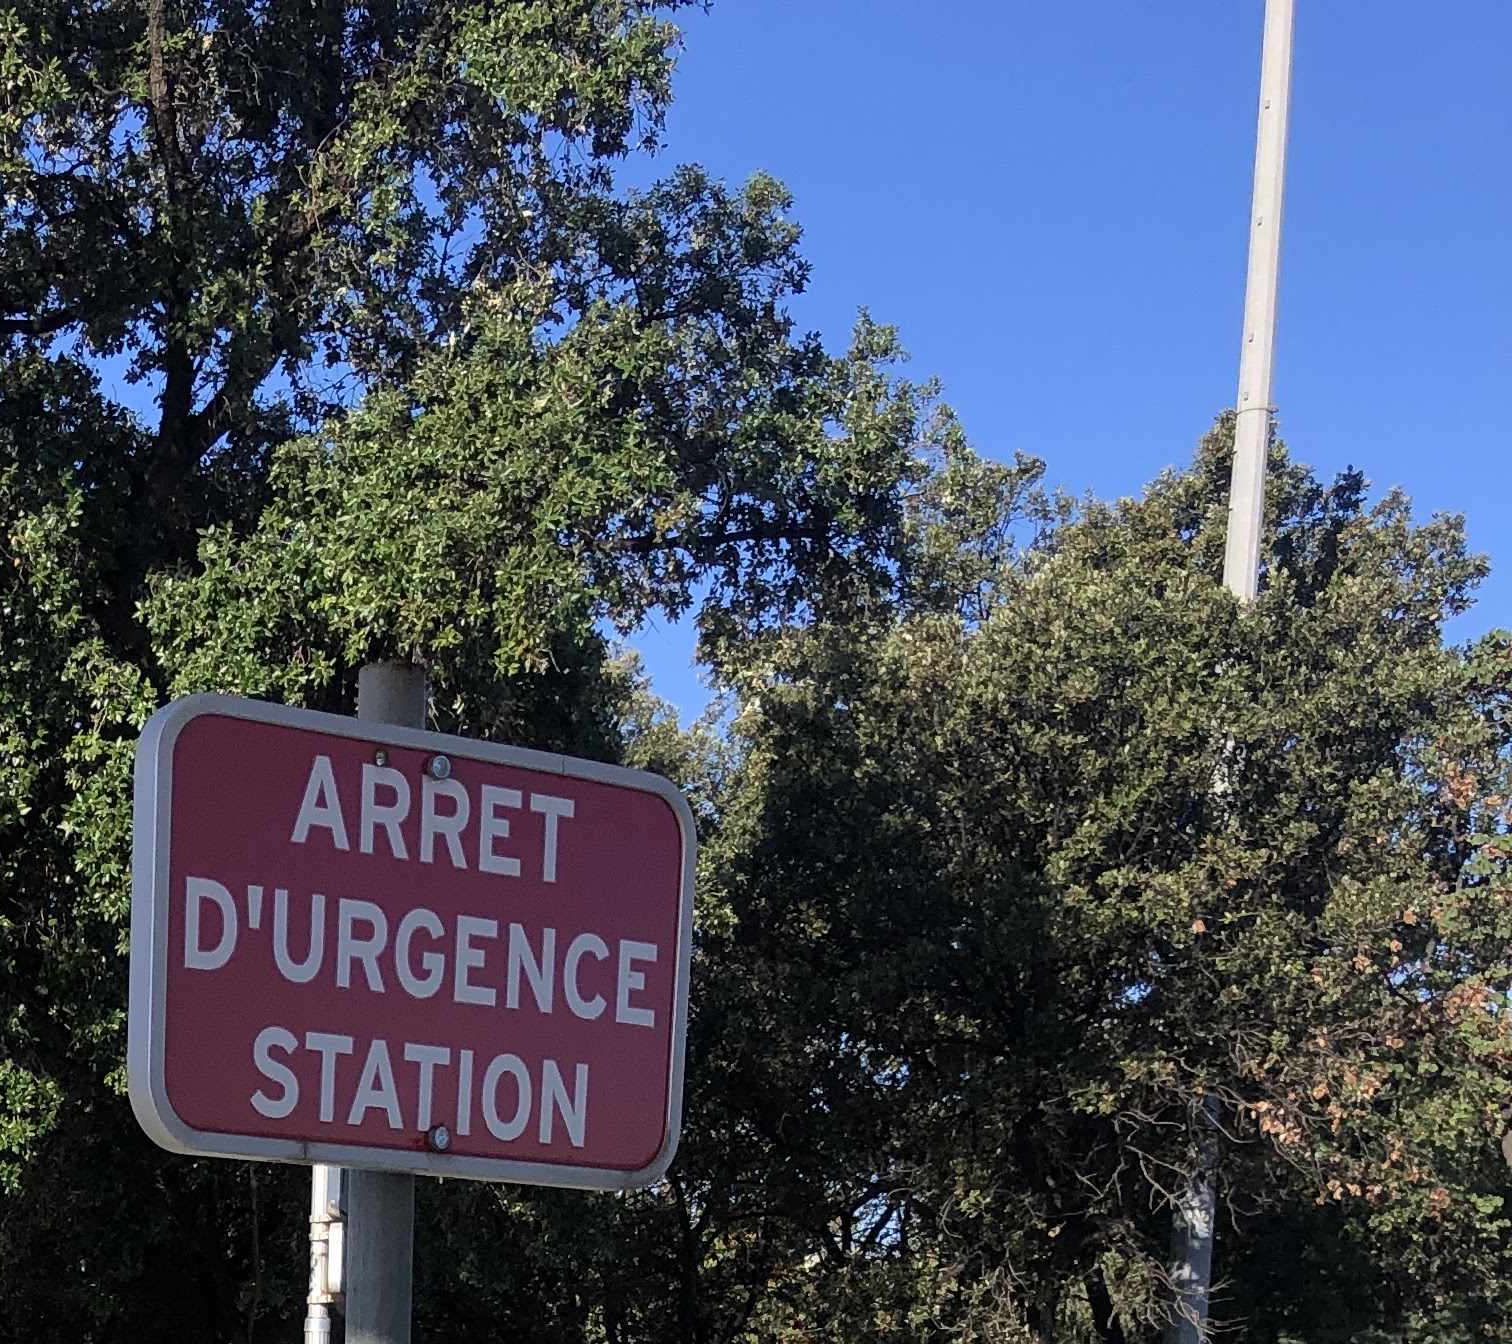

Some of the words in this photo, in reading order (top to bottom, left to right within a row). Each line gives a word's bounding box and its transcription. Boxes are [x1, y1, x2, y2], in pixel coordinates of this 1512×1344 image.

[291, 755, 575, 883] ARRET
[184, 876, 658, 1029] D'URGENCE
[250, 1026, 589, 1148] STATION
